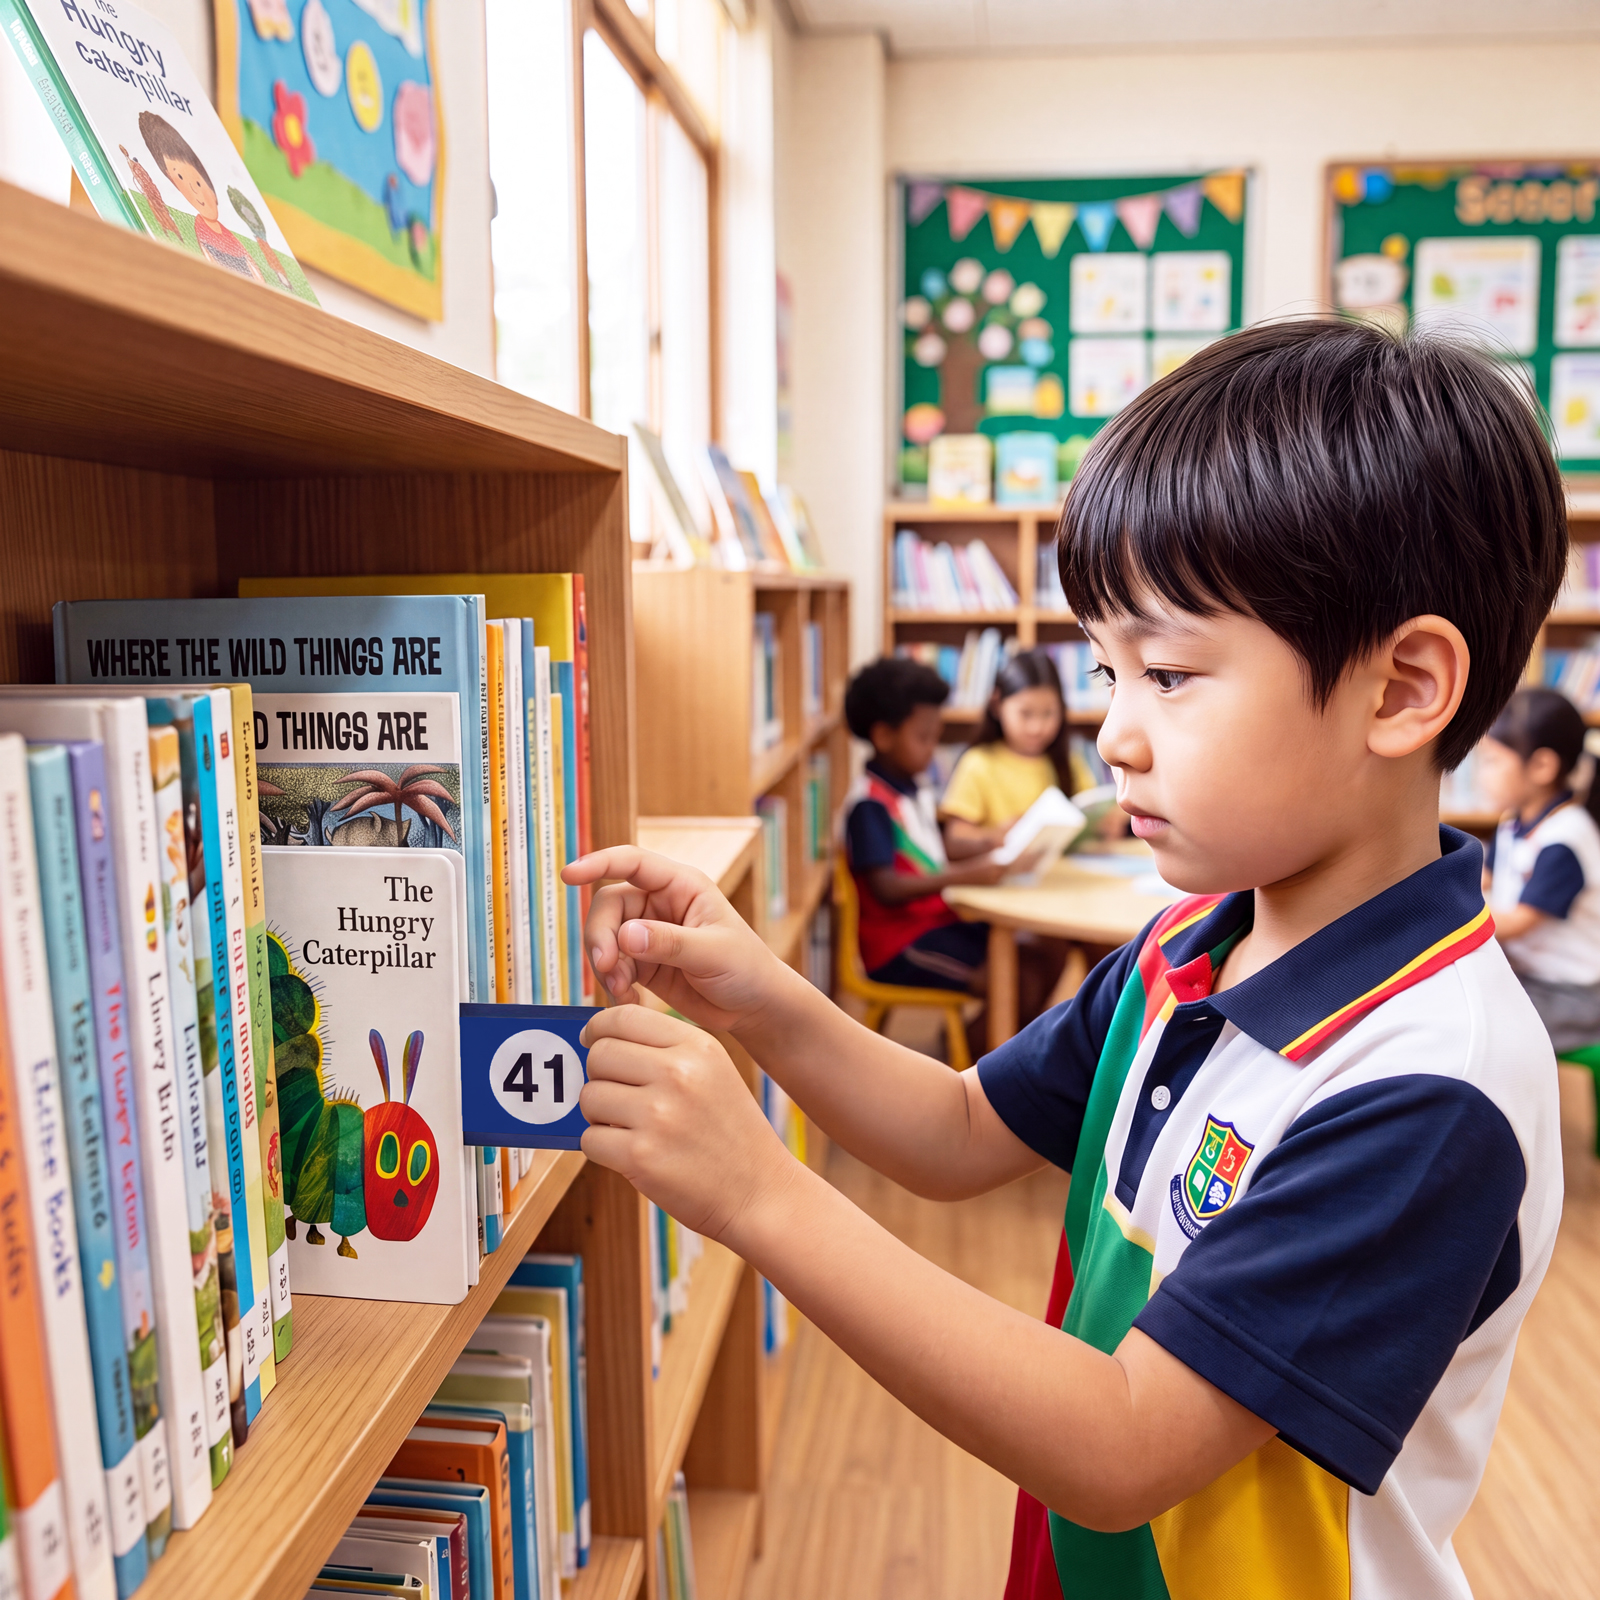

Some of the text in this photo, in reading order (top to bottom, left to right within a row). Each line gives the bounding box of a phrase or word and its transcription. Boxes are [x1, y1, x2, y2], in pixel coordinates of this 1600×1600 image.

[61, 0, 166, 78] Hungry
[75, 41, 193, 116] caterpillar
[87, 636, 442, 678] WHERE THE WILD THINGS ARE
[276, 710, 369, 751] THINGS
[377, 711, 429, 751] ARE
[384, 876, 434, 903] The
[337, 907, 435, 941] Hungry
[302, 939, 437, 974] Caterpillar
[502, 1053, 564, 1103] 41
